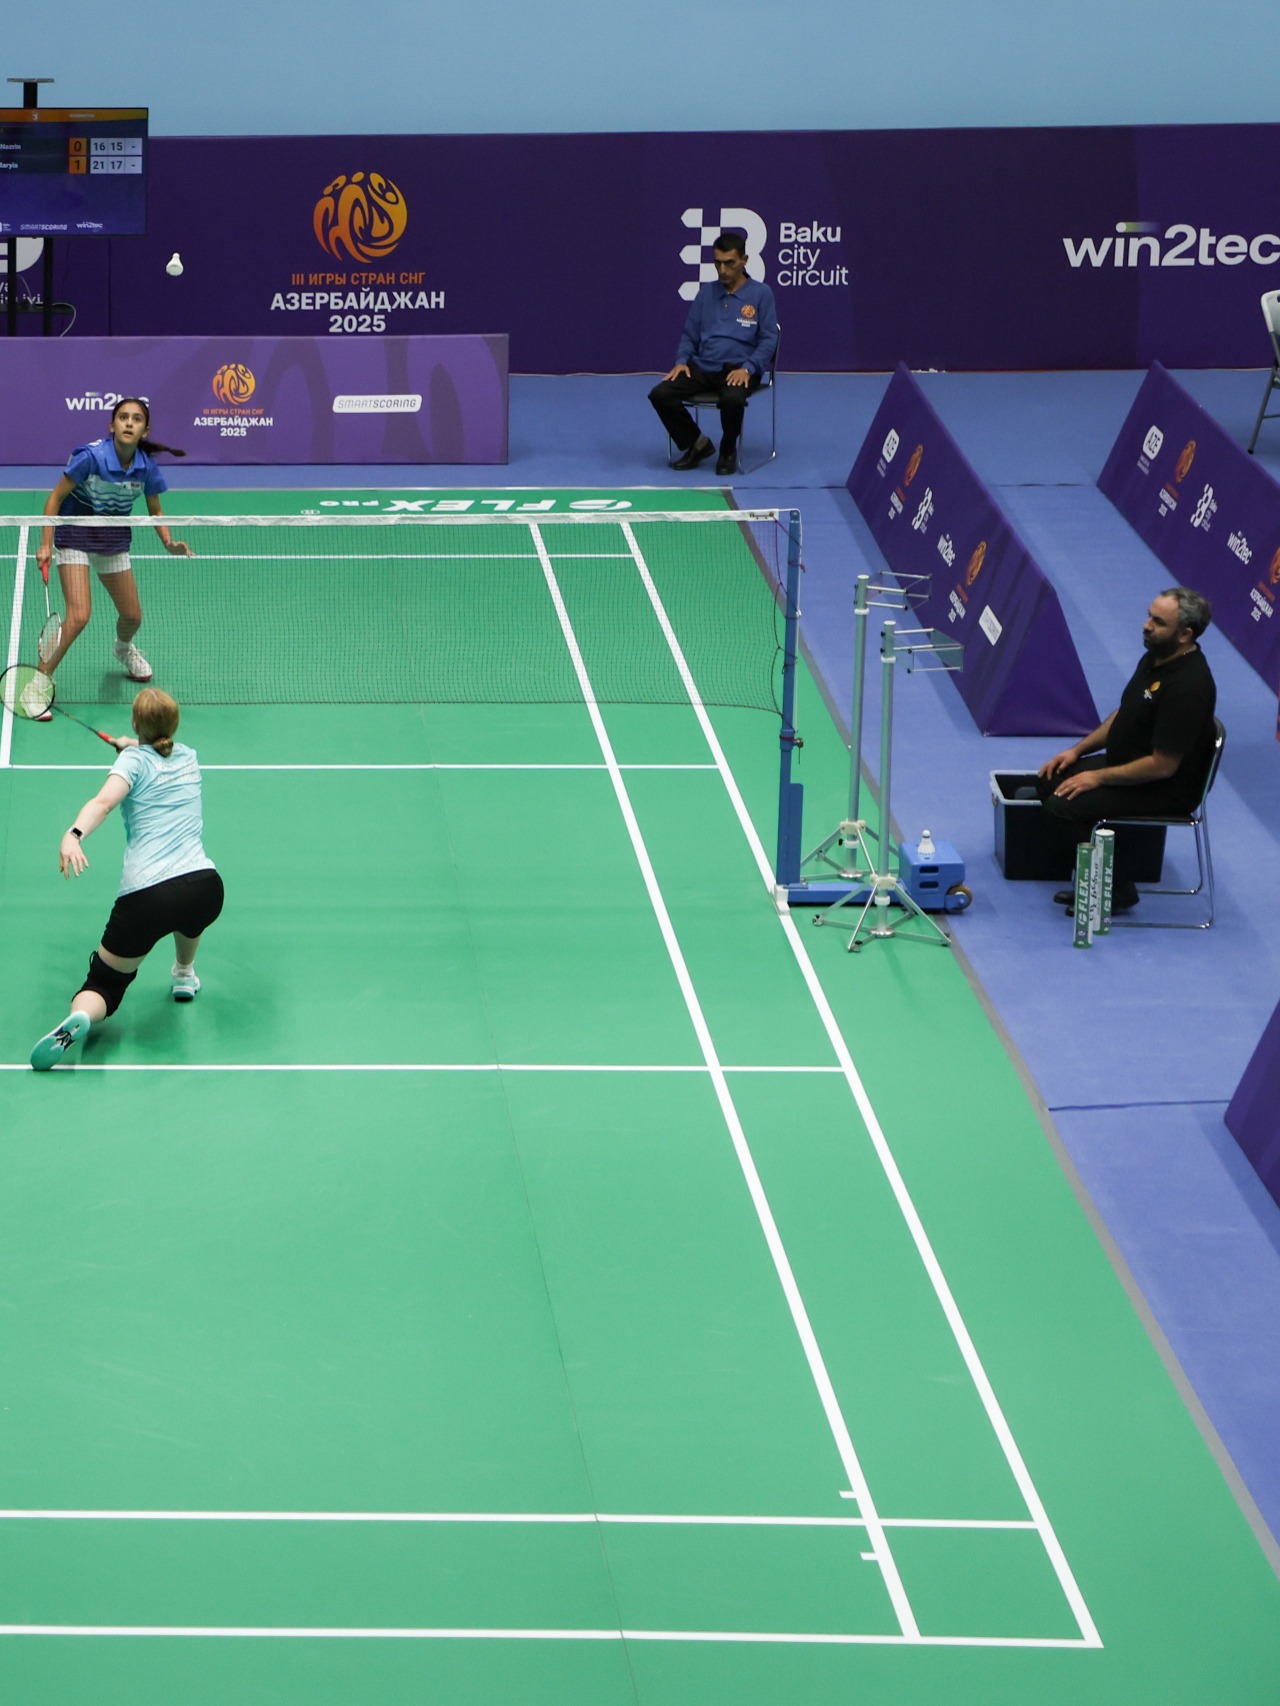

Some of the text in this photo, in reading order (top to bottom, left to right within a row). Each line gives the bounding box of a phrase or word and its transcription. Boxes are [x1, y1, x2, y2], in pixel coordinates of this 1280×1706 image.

[74, 141, 82, 151] 0
[93, 142, 123, 151] 16 15
[92, 161, 123, 170] 21 17
[779, 220, 841, 243] Baku
[1062, 221, 1280, 267] win2tec
[778, 244, 821, 270] city
[309, 273, 346, 285] ИГРЫ
[350, 272, 396, 285] СТРАН
[399, 272, 426, 285] СНГ
[777, 265, 849, 286] circuit
[270, 287, 445, 312] АЗЕРБАЙДЖАН
[328, 314, 386, 333] 2025
[337, 398, 417, 409] SMARTSCORING
[193, 415, 273, 427] АЗЕРБАЙДЖАН
[220, 427, 247, 437] 2025
[381, 499, 557, 511] FLEX
[1104, 867, 1113, 898] FLEX
[1079, 879, 1089, 912] FLEX
